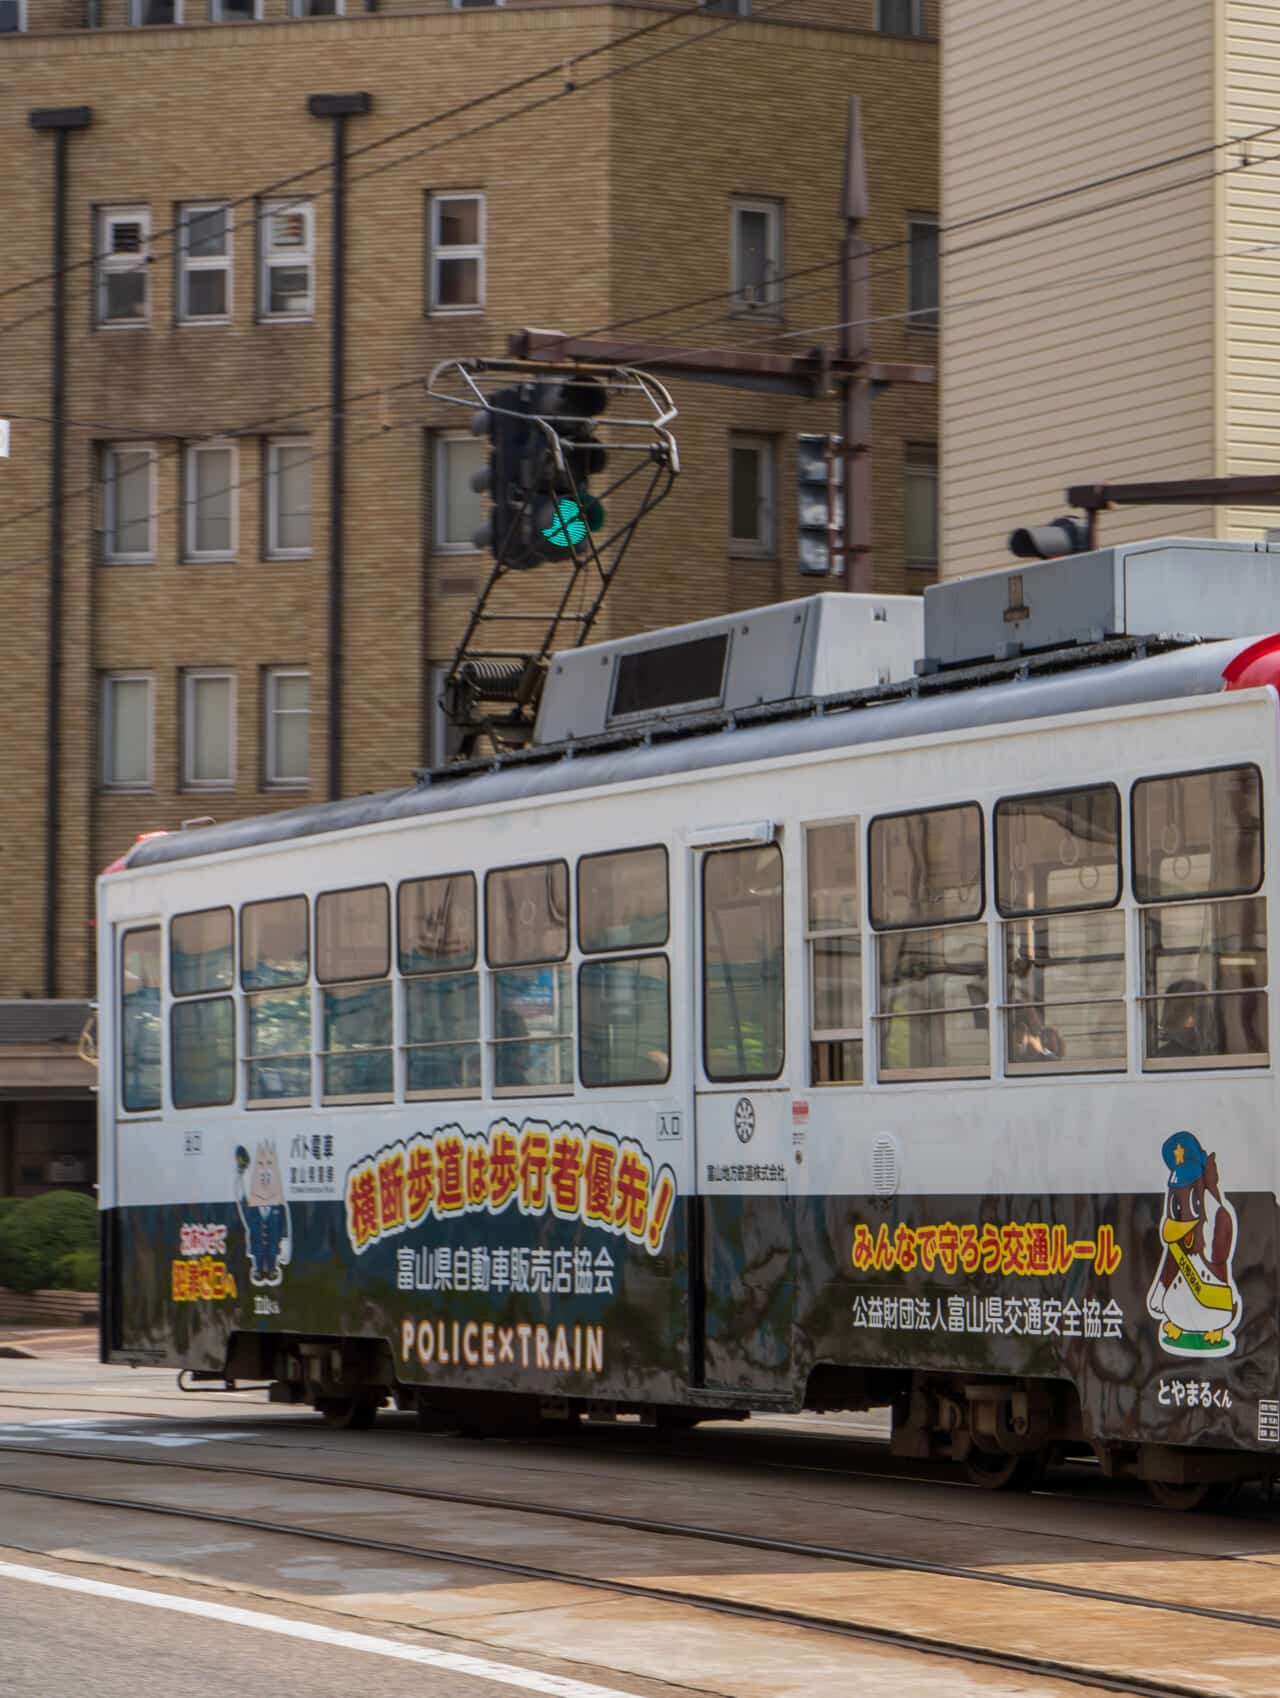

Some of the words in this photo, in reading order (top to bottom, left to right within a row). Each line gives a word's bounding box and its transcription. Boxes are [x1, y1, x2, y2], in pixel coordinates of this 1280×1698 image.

[660, 1116, 680, 1136] 入口
[396, 1246, 615, 1294] 富山県自動車販売店協会
[853, 1222, 1122, 1275] みんなで守ろう交通ルール
[852, 1294, 1124, 1339] 公益財団法人富山県交通安全協会
[1158, 1379, 1232, 1408] とやまるくん
